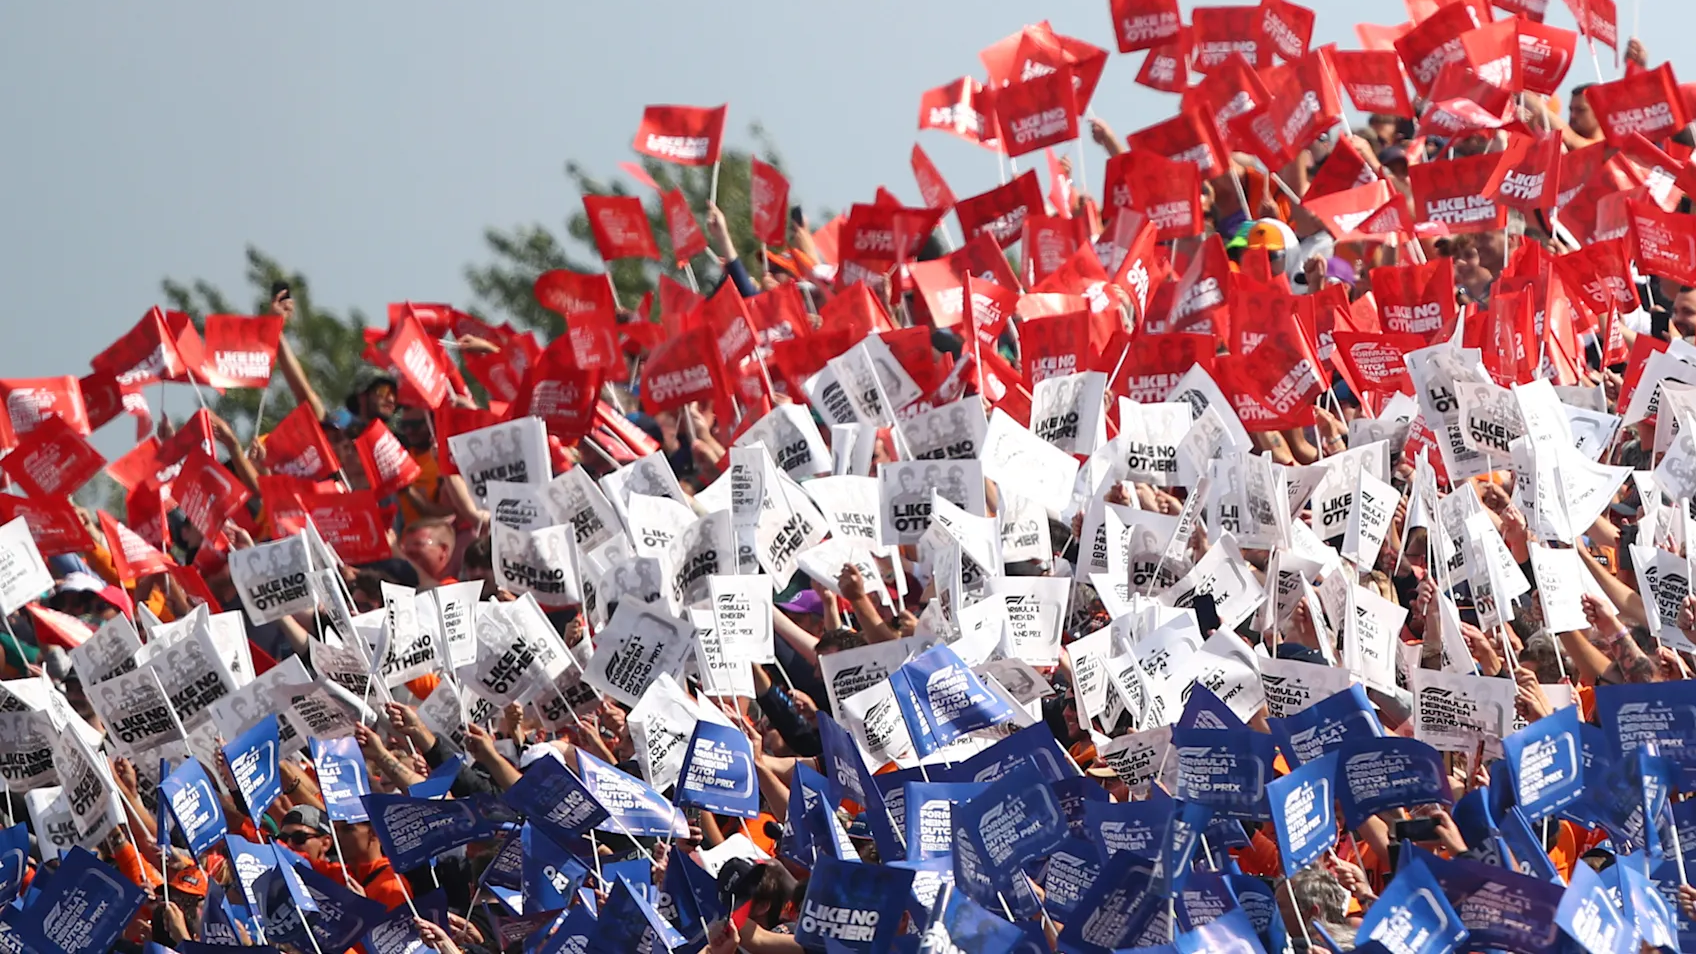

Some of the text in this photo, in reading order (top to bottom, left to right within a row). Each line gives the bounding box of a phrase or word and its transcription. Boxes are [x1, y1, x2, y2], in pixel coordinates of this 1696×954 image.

[1645, 102, 1669, 118] NO
[1427, 198, 1462, 215] LIKE
[1384, 303, 1440, 323] LIKE NO
[1388, 316, 1442, 333] OTHER!
[944, 439, 974, 457] NO
[1158, 446, 1175, 458] NO
[1129, 457, 1177, 472] OTHER!
[471, 468, 507, 486] LIKE
[894, 503, 930, 518] LIKE
[694, 550, 716, 564] NO
[503, 559, 564, 581] LIKE NO
[248, 573, 306, 601] LIKE NO
[504, 570, 565, 594] OTHER!
[675, 561, 718, 602] OTHER!
[257, 581, 309, 611] OTHER!
[611, 644, 636, 685] FORMULA
[632, 642, 665, 696] GRAND PRIX
[624, 662, 644, 693] DUTCH
[1222, 684, 1244, 703] PRIX
[1420, 694, 1469, 710] FORMULA
[113, 707, 168, 732] LIKE NO
[1421, 708, 1455, 720] DUTCH
[1421, 716, 1458, 726] GRAND
[122, 720, 176, 743] OTHER!
[27, 747, 52, 761] NO
[666, 732, 686, 756] PRIX
[715, 778, 735, 789] PRIX
[1213, 783, 1240, 792] PRIX
[46, 897, 81, 940] FORMULA
[805, 902, 879, 928] LIKE NO
[61, 920, 86, 949] DUTCH
[67, 900, 109, 953] GRAND PRIX
[802, 919, 876, 943] OTHER!
